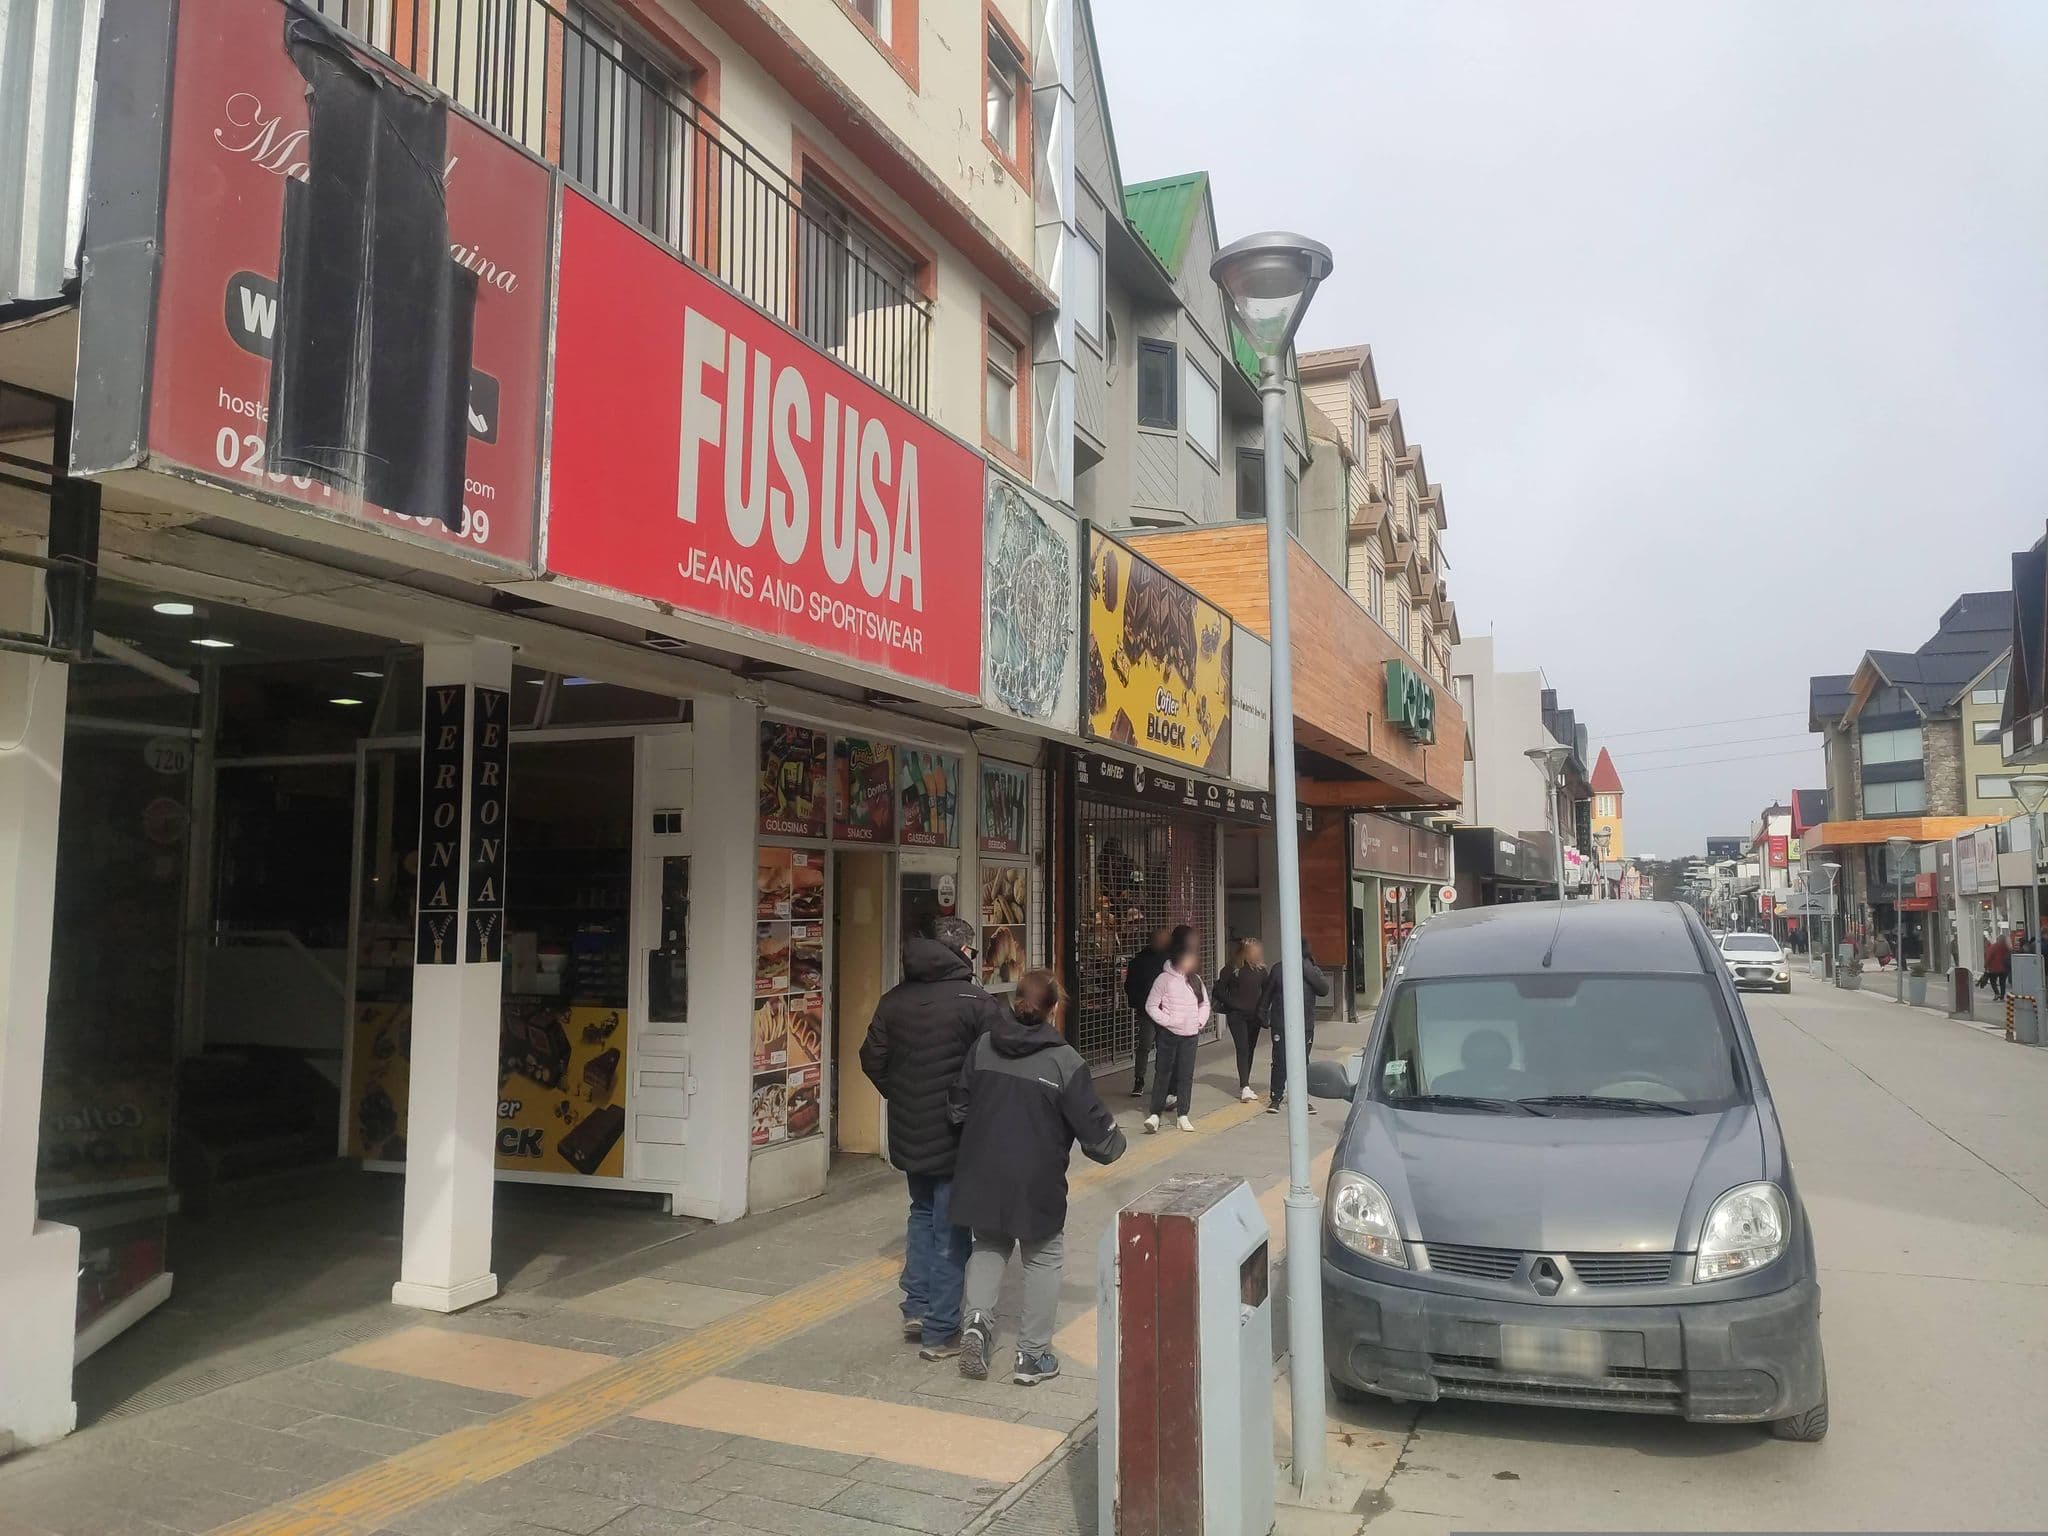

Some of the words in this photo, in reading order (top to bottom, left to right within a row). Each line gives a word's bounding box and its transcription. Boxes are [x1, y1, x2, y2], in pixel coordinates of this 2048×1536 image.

[677, 305, 811, 565] FUS
[821, 392, 922, 612] USA
[678, 547, 753, 598] JEANS
[759, 575, 804, 614] AND
[809, 592, 922, 654] SPORTSWEAR
[429, 689, 457, 907] VERONA
[478, 691, 499, 902] VERONA
[1147, 712, 1186, 751] BLOCK
[765, 819, 808, 834] GOLOSINAS
